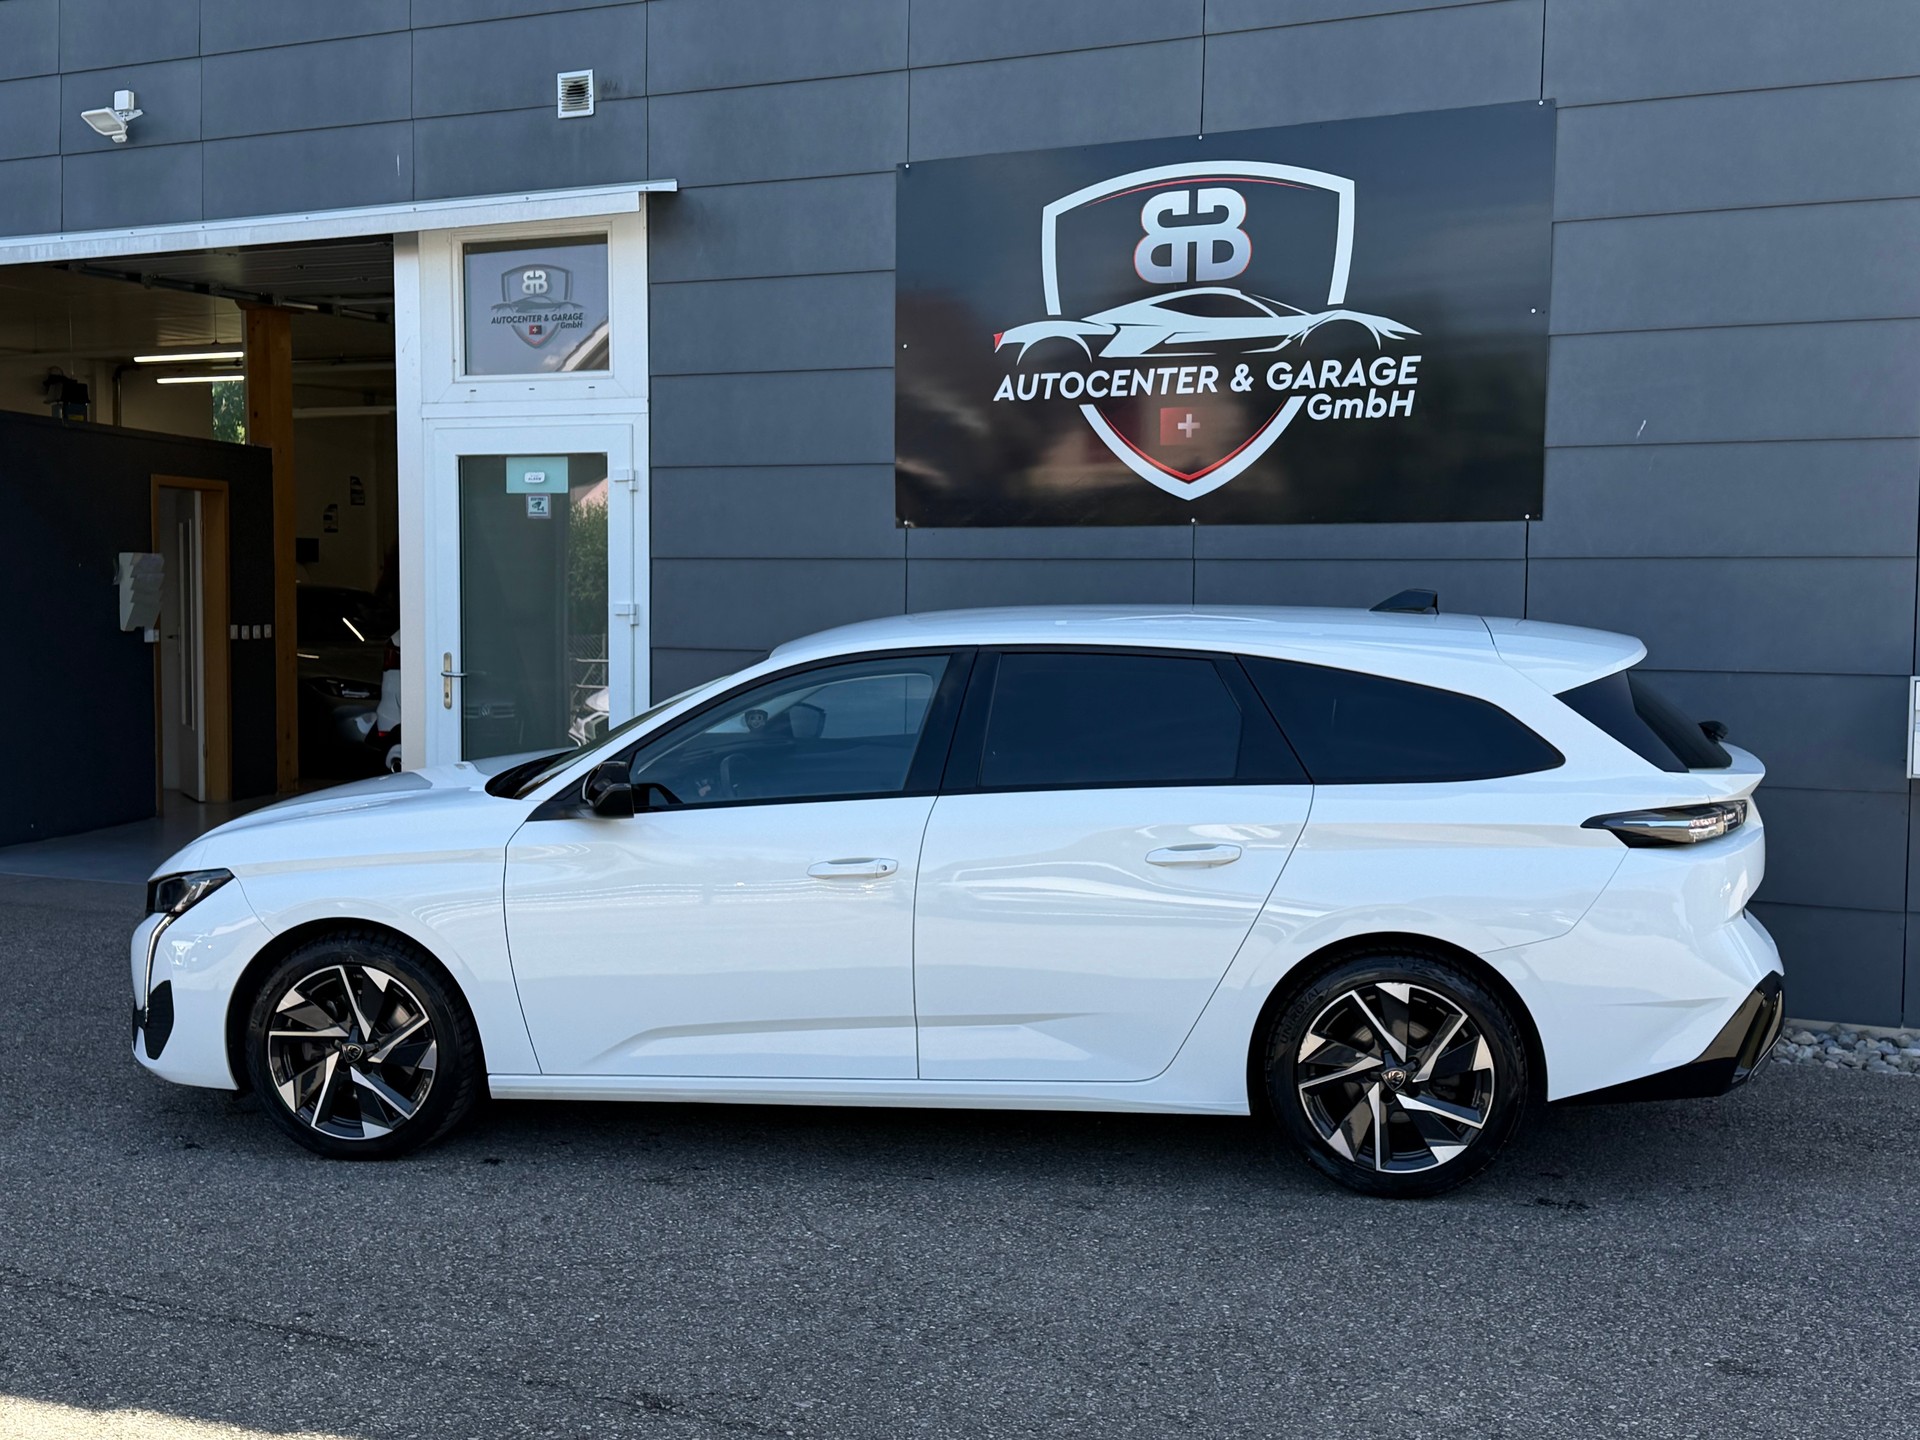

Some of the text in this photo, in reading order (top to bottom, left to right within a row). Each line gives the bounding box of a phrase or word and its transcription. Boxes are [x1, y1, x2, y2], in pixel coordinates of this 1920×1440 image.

[491, 312, 584, 325] AUTOCENTER & GARAGE
[560, 321, 583, 329] GmbH
[993, 355, 1422, 401] AUTOCENTER & GARAGE
[1307, 389, 1415, 420] GmbH
